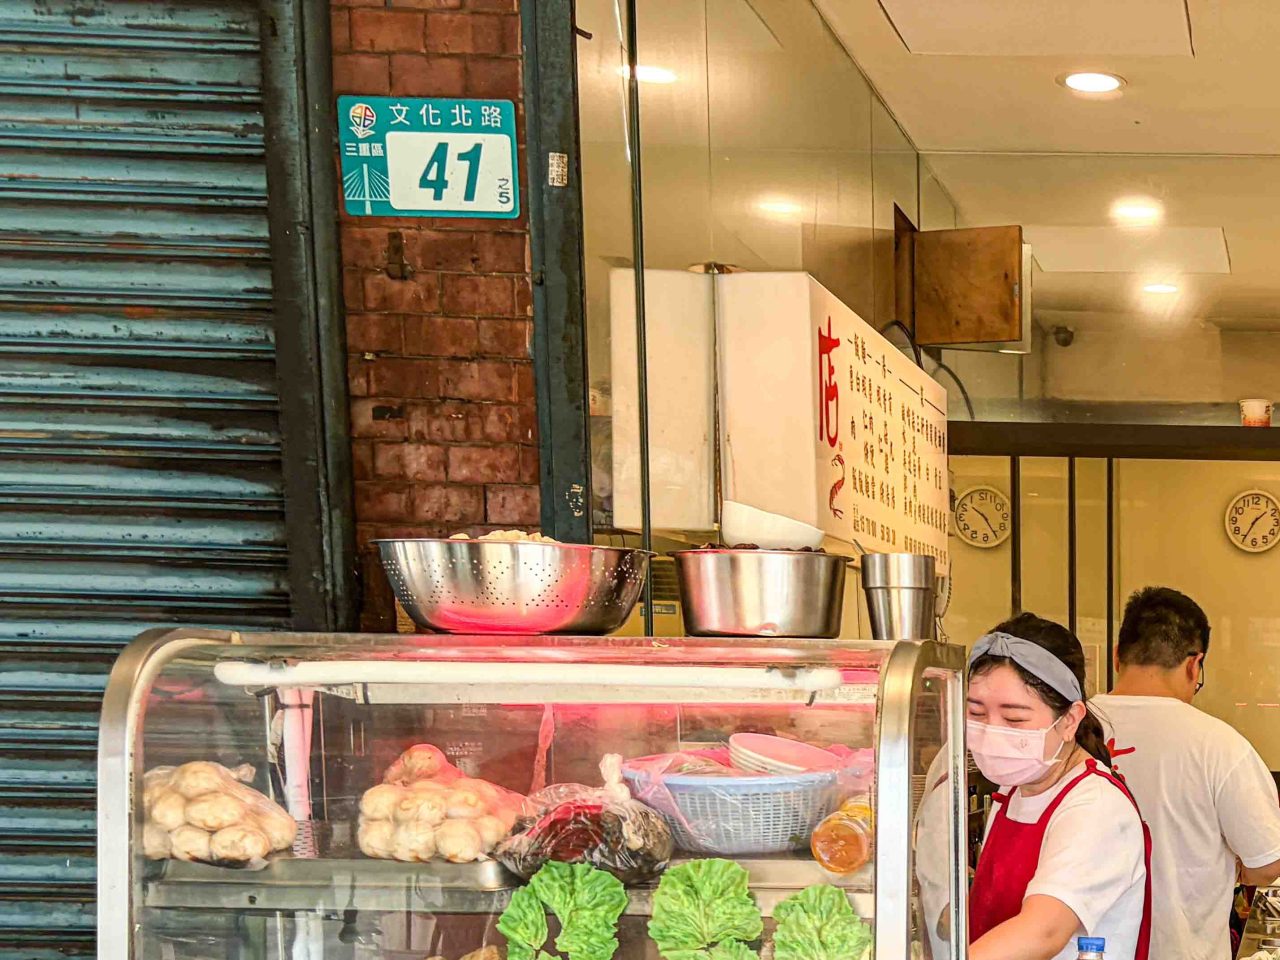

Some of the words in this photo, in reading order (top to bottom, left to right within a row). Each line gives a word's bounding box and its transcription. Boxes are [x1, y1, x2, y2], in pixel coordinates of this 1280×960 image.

[389, 103, 502, 127] 文化北路
[345, 142, 384, 157] 三重區
[419, 142, 484, 202] 41
[1243, 499, 1249, 507] 11
[1252, 496, 1260, 505] 12
[1265, 500, 1269, 508] 1
[1235, 506, 1244, 515] 10
[1270, 508, 1277, 517] 2
[1231, 516, 1238, 525] 9
[1273, 518, 1279, 527] 3
[1233, 526, 1240, 535] 8
[1269, 528, 1275, 536] 4
[1241, 534, 1247, 543] 7
[1251, 537, 1258, 546] 6
[1261, 535, 1268, 544] 5
